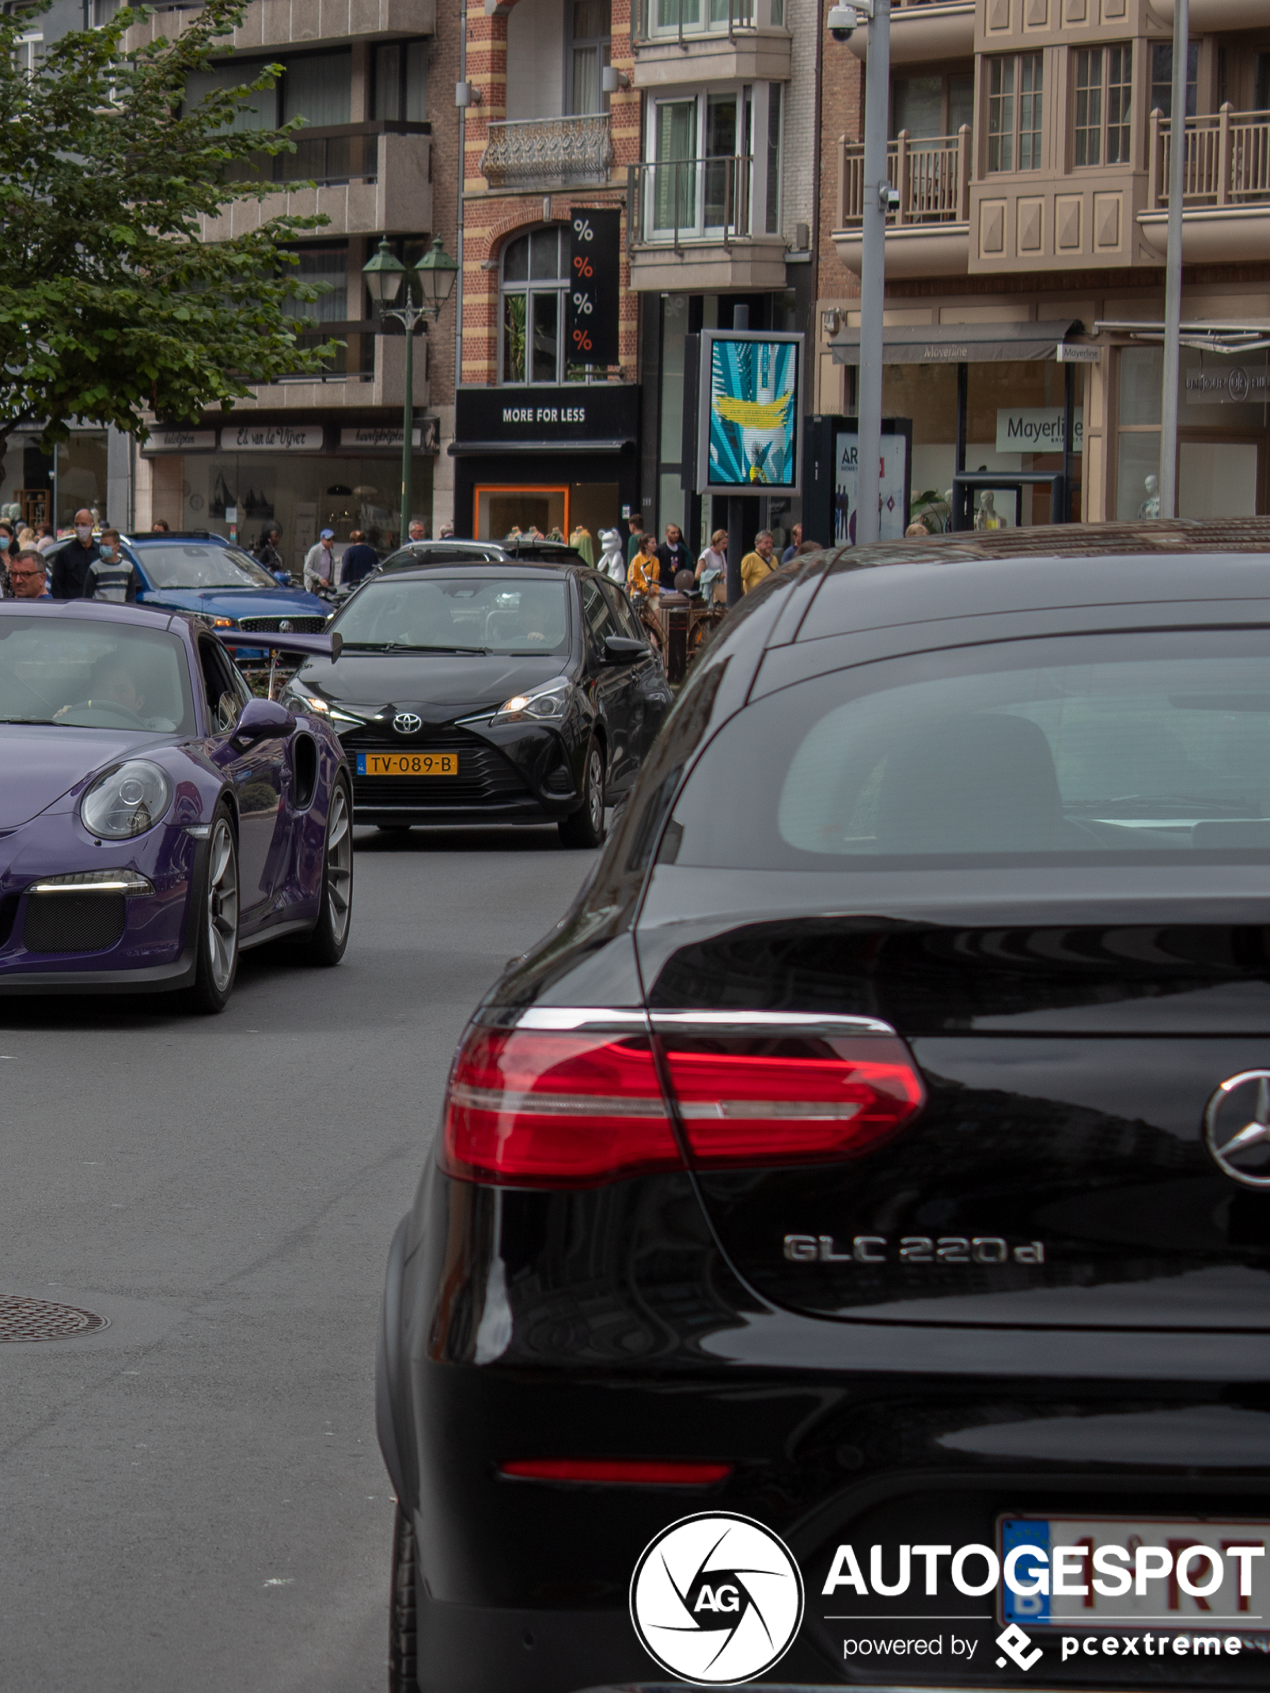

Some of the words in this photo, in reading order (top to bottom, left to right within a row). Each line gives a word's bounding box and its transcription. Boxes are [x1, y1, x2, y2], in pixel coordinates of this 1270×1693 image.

[574, 219, 593, 241] %
[573, 257, 593, 277] %
[573, 293, 593, 314] %
[573, 330, 592, 350] %
[923, 345, 967, 358] Mayerline
[1064, 348, 1098, 360] Mayerline
[502, 408, 533, 422] MORE
[536, 408, 558, 422] FOR
[561, 408, 585, 422] LESS
[251, 433, 264, 446] van
[266, 427, 275, 445] de
[276, 427, 306, 449] Vijver
[1007, 416, 1083, 443] Mayerlie
[371, 757, 451, 772] TV-089-B
[784, 1234, 887, 1263] GLC
